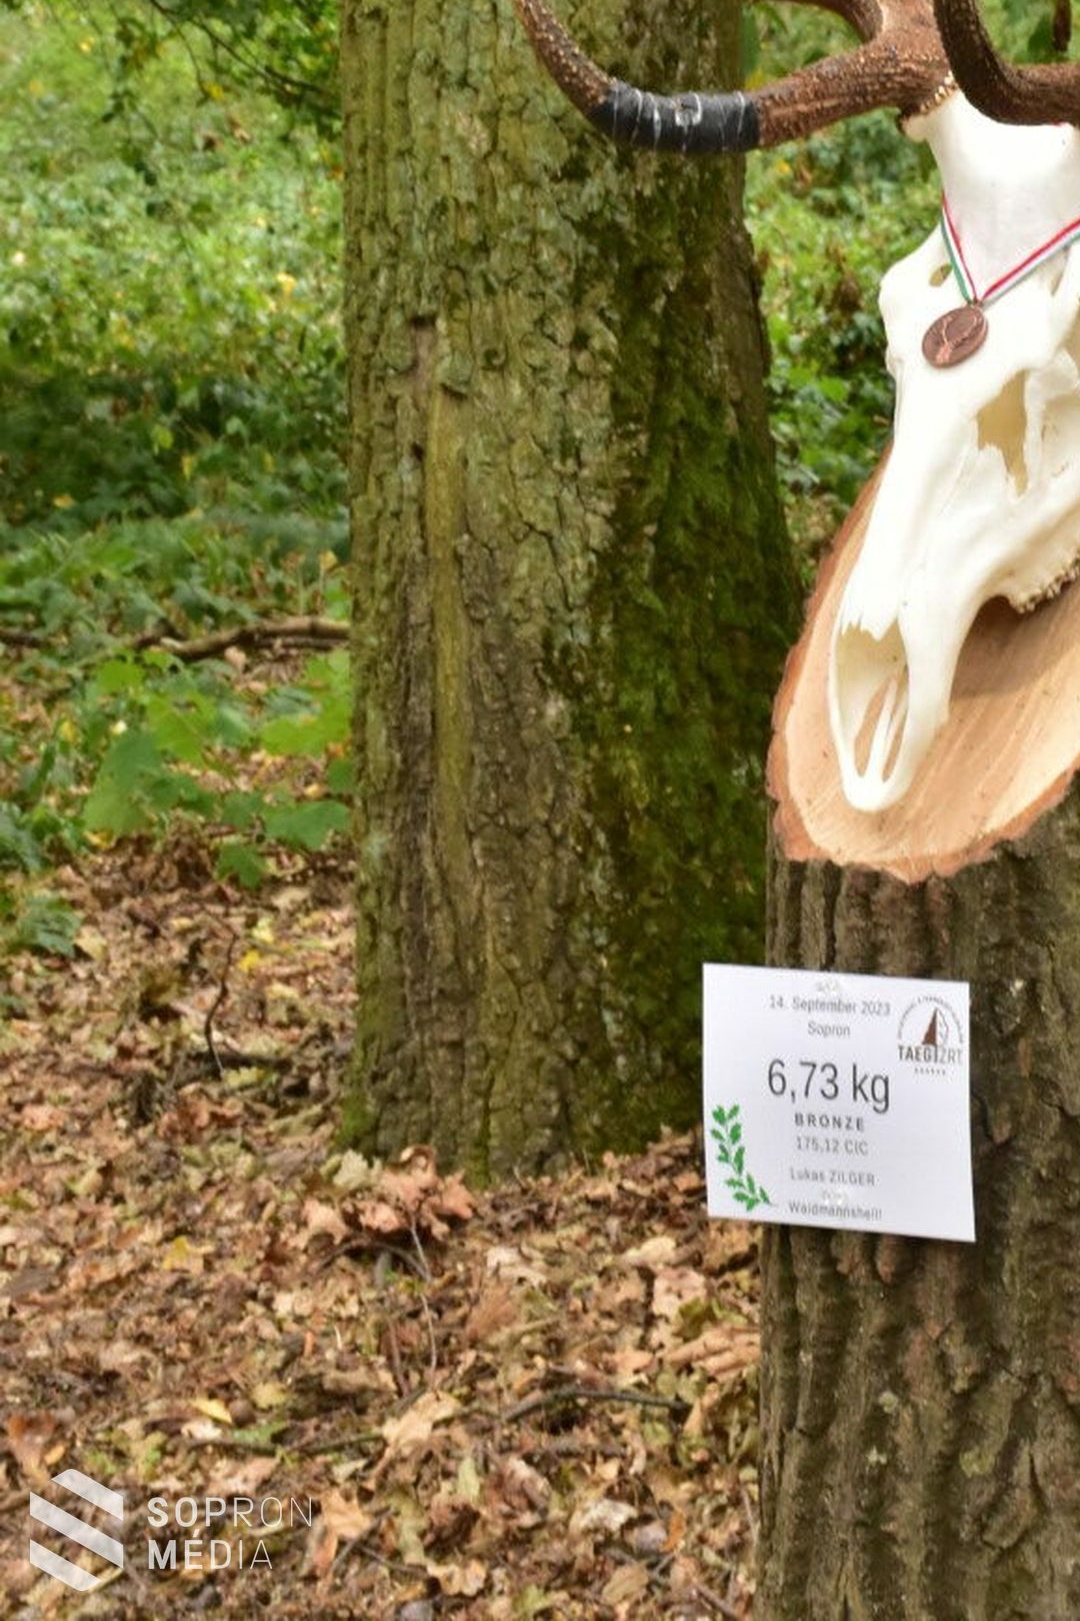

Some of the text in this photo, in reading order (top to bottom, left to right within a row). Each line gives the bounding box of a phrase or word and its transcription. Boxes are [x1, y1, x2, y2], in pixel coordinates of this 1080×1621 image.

[792, 996, 857, 1014] September
[861, 1000, 892, 1016] 2023
[807, 1020, 851, 1038] Sopron
[768, 1059, 890, 1115] 6,73 kg
[794, 1112, 865, 1132] BRONZE
[843, 1139, 869, 1156] CIC
[789, 1166, 825, 1182] Lukas
